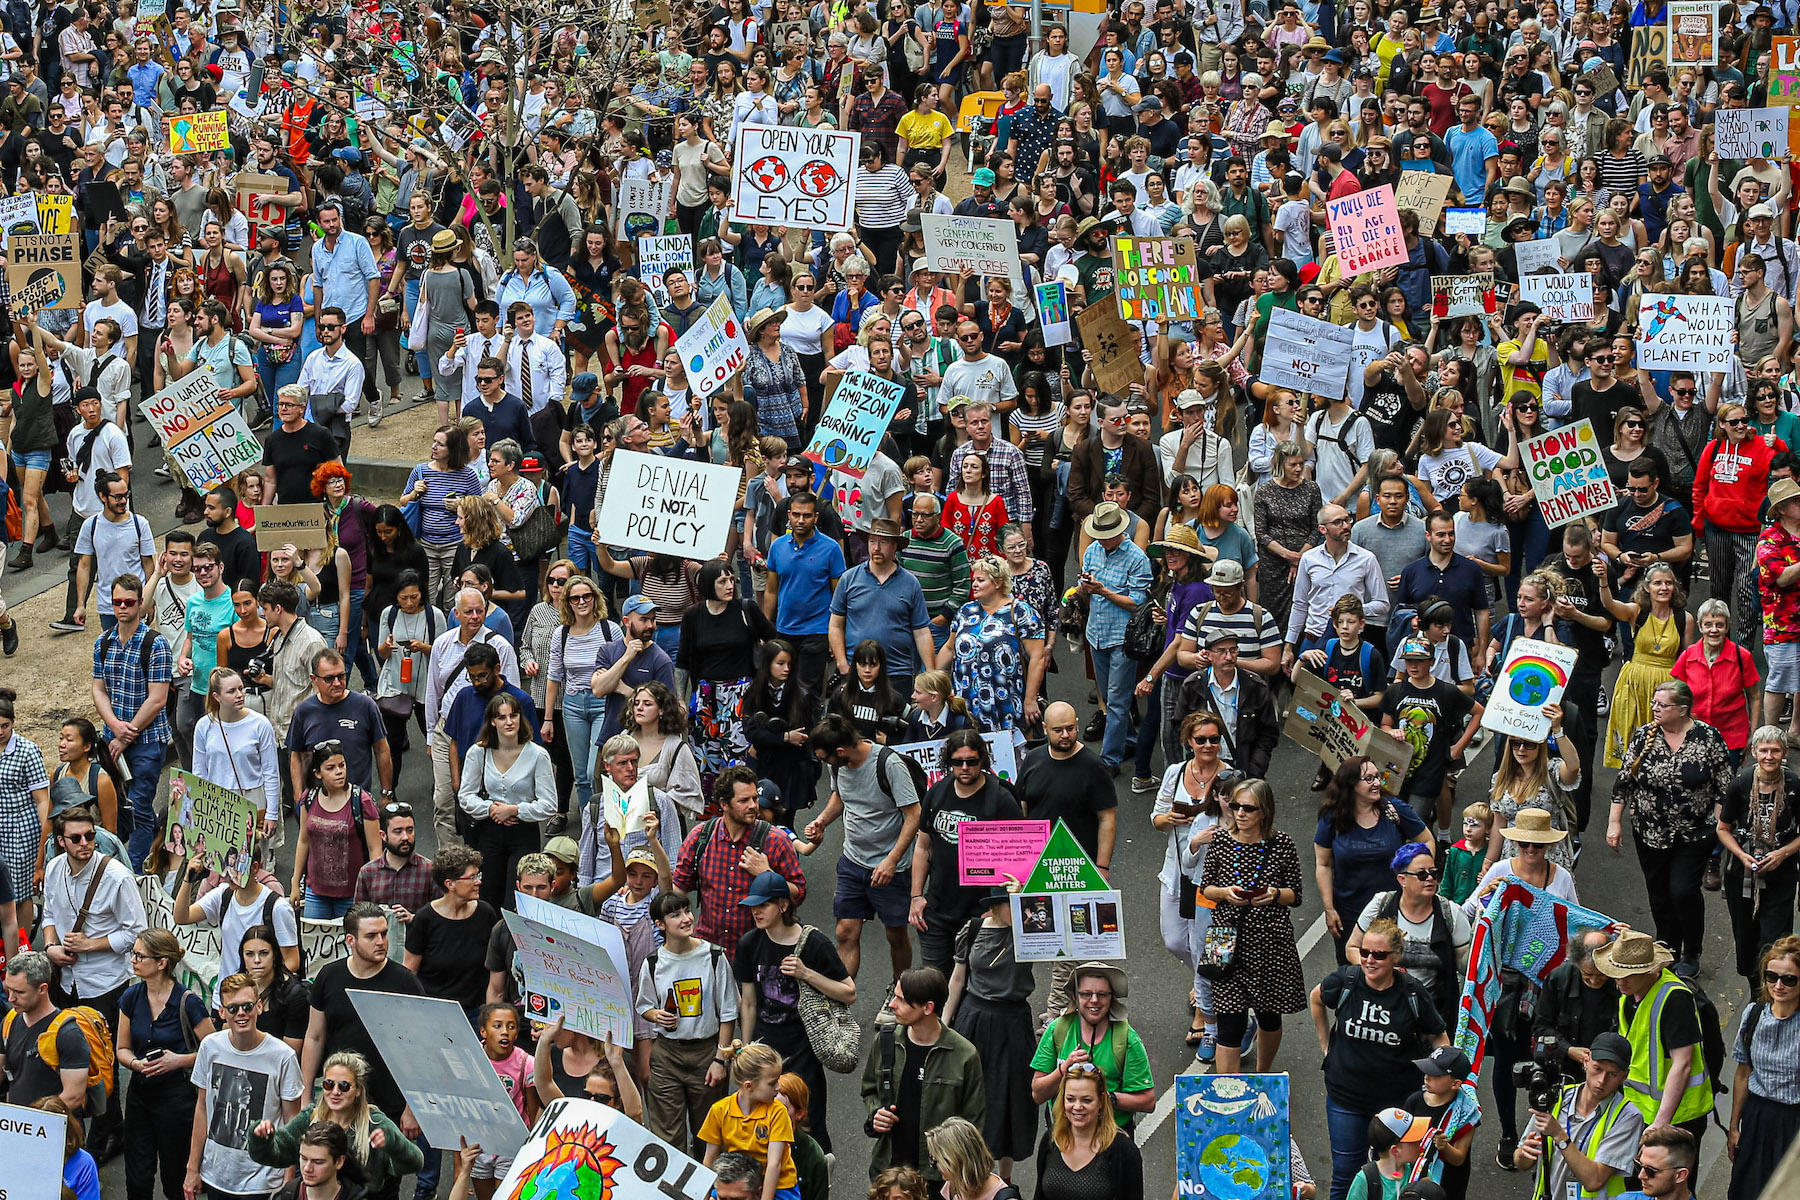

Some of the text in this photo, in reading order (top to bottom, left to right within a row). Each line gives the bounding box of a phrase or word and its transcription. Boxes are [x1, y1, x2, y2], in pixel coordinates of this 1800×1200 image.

[1672, 5, 1695, 14] green
[1683, 16, 1706, 24] SYSTEM
[1634, 27, 1665, 57] NO
[1717, 111, 1742, 123] WHAT
[1717, 119, 1784, 134] STAND FOR IS
[193, 122, 226, 134] RUNNING
[196, 140, 224, 152] TIME
[762, 129, 836, 158] OPEN YOUR
[1718, 133, 1740, 144] WHAT
[1719, 141, 1777, 160] STAND ON
[53, 195, 68, 205] NEED
[1366, 191, 1384, 208] DIE
[1398, 195, 1438, 210] ENUFF
[757, 195, 828, 225] EYES
[952, 218, 982, 230] FAMILY
[1338, 215, 1385, 236] OLD AGE
[1362, 228, 1380, 243] DIE
[1385, 225, 1396, 235] OF
[39, 235, 72, 246] NOT A
[645, 237, 691, 252] I KINDA
[943, 228, 995, 241] GENERATIONS
[14, 246, 73, 263] PHASE
[937, 239, 1006, 252] VERY CONCERNED
[1117, 239, 1185, 269] THERE IS
[1341, 237, 1398, 260] CLIMATE
[641, 251, 691, 262] LIKE DON'T
[938, 257, 1009, 273] CLIMATE CRISIS
[1349, 246, 1400, 271] CHANGE
[641, 262, 668, 275] REALLY
[1118, 264, 1195, 286] NO ECONOMY
[11, 274, 55, 304] RESPECT
[1449, 274, 1492, 286] TOO DAMN
[1527, 274, 1590, 291] IT WOULD BE
[22, 287, 47, 305] YOUR
[1434, 287, 1453, 296] HOT
[1454, 285, 1490, 295] GETTING
[1542, 291, 1578, 305] COOLER
[1120, 286, 1135, 299] ON
[1139, 285, 1148, 299] A
[1157, 284, 1203, 318] PLANET
[1122, 299, 1159, 320] DEAD
[1548, 306, 1567, 319] TAKE
[1570, 302, 1593, 319] ACTION
[1688, 302, 1733, 316] WHAT
[1284, 318, 1342, 341] CHANGE
[1687, 318, 1733, 332] WOULD
[704, 330, 725, 358] EARTH
[1660, 333, 1723, 346] CAPTAIN
[1279, 343, 1336, 366] CULTURE
[1644, 349, 1730, 364] PLANET DO?
[700, 346, 744, 393] GONE
[1292, 359, 1320, 374] NOT
[1297, 371, 1312, 379] THE
[843, 371, 900, 402] THE WRONG
[1276, 371, 1333, 393] CLIMATE
[149, 375, 215, 418] NO WATER
[836, 387, 891, 420] AMAZON
[162, 388, 226, 437] NO LIFE
[844, 408, 858, 422] IS
[211, 422, 235, 443] NO
[821, 415, 876, 446] BURNING
[177, 443, 202, 463] NO
[222, 436, 262, 467] GREEN
[1529, 426, 1577, 462] HOW
[186, 452, 225, 488] BLUE
[1532, 448, 1597, 481] GOOD
[638, 464, 709, 501] DENIAL
[1553, 469, 1587, 495] ARE
[641, 495, 697, 518] IS NOT A
[261, 519, 319, 528] #RenewOurWorld
[626, 512, 705, 547] POLICY
[1316, 692, 1369, 740] SORRY
[1493, 702, 1540, 723] Save Earth
[1502, 715, 1539, 735] NOW!
[202, 791, 234, 811] HAVE MY
[220, 788, 241, 805] BETTER
[193, 798, 241, 831] CLIMATE
[194, 813, 240, 847] JUSTICE
[1042, 857, 1086, 867] STANDING
[1049, 865, 1080, 874] UP FOR
[1045, 880, 1087, 890] MATTERS
[1053, 873, 1078, 881] WHAT
[515, 893, 581, 938] WHAT
[533, 947, 614, 984] CAN'T TIDY
[543, 959, 562, 975] MY
[543, 978, 576, 999] HAVE
[604, 999, 628, 1017] SAVE
[1360, 1000, 1391, 1026] It's
[406, 1090, 517, 1126] CLIMATE
[0, 1118, 47, 1139] GIVE A
[633, 1142, 698, 1200] TO
[1178, 1179, 1206, 1196] No
